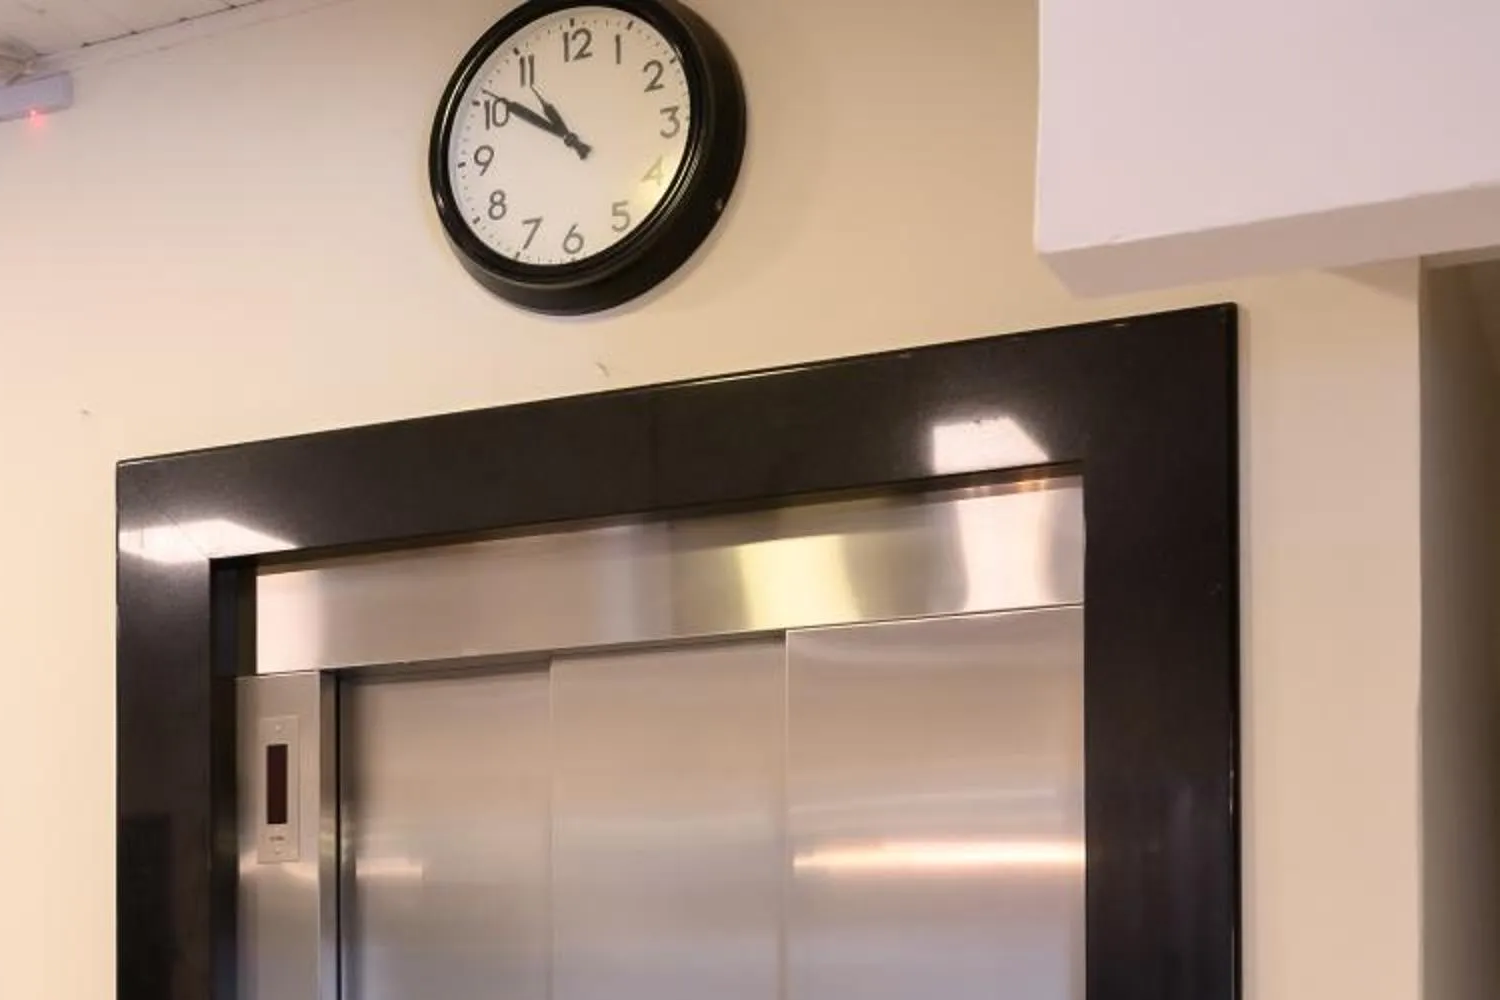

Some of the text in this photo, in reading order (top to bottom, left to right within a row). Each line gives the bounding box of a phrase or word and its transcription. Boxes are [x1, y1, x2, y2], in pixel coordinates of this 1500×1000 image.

[563, 28, 594, 63] 12
[615, 34, 622, 64] 1
[519, 55, 535, 88] 11
[643, 60, 665, 92] 2
[483, 100, 510, 131] 10
[660, 106, 681, 139] 3
[473, 145, 495, 176] 9
[641, 155, 664, 185] 4
[488, 190, 507, 220] 8
[611, 201, 631, 232] 5
[522, 218, 544, 249] 7
[563, 225, 585, 254] 6
